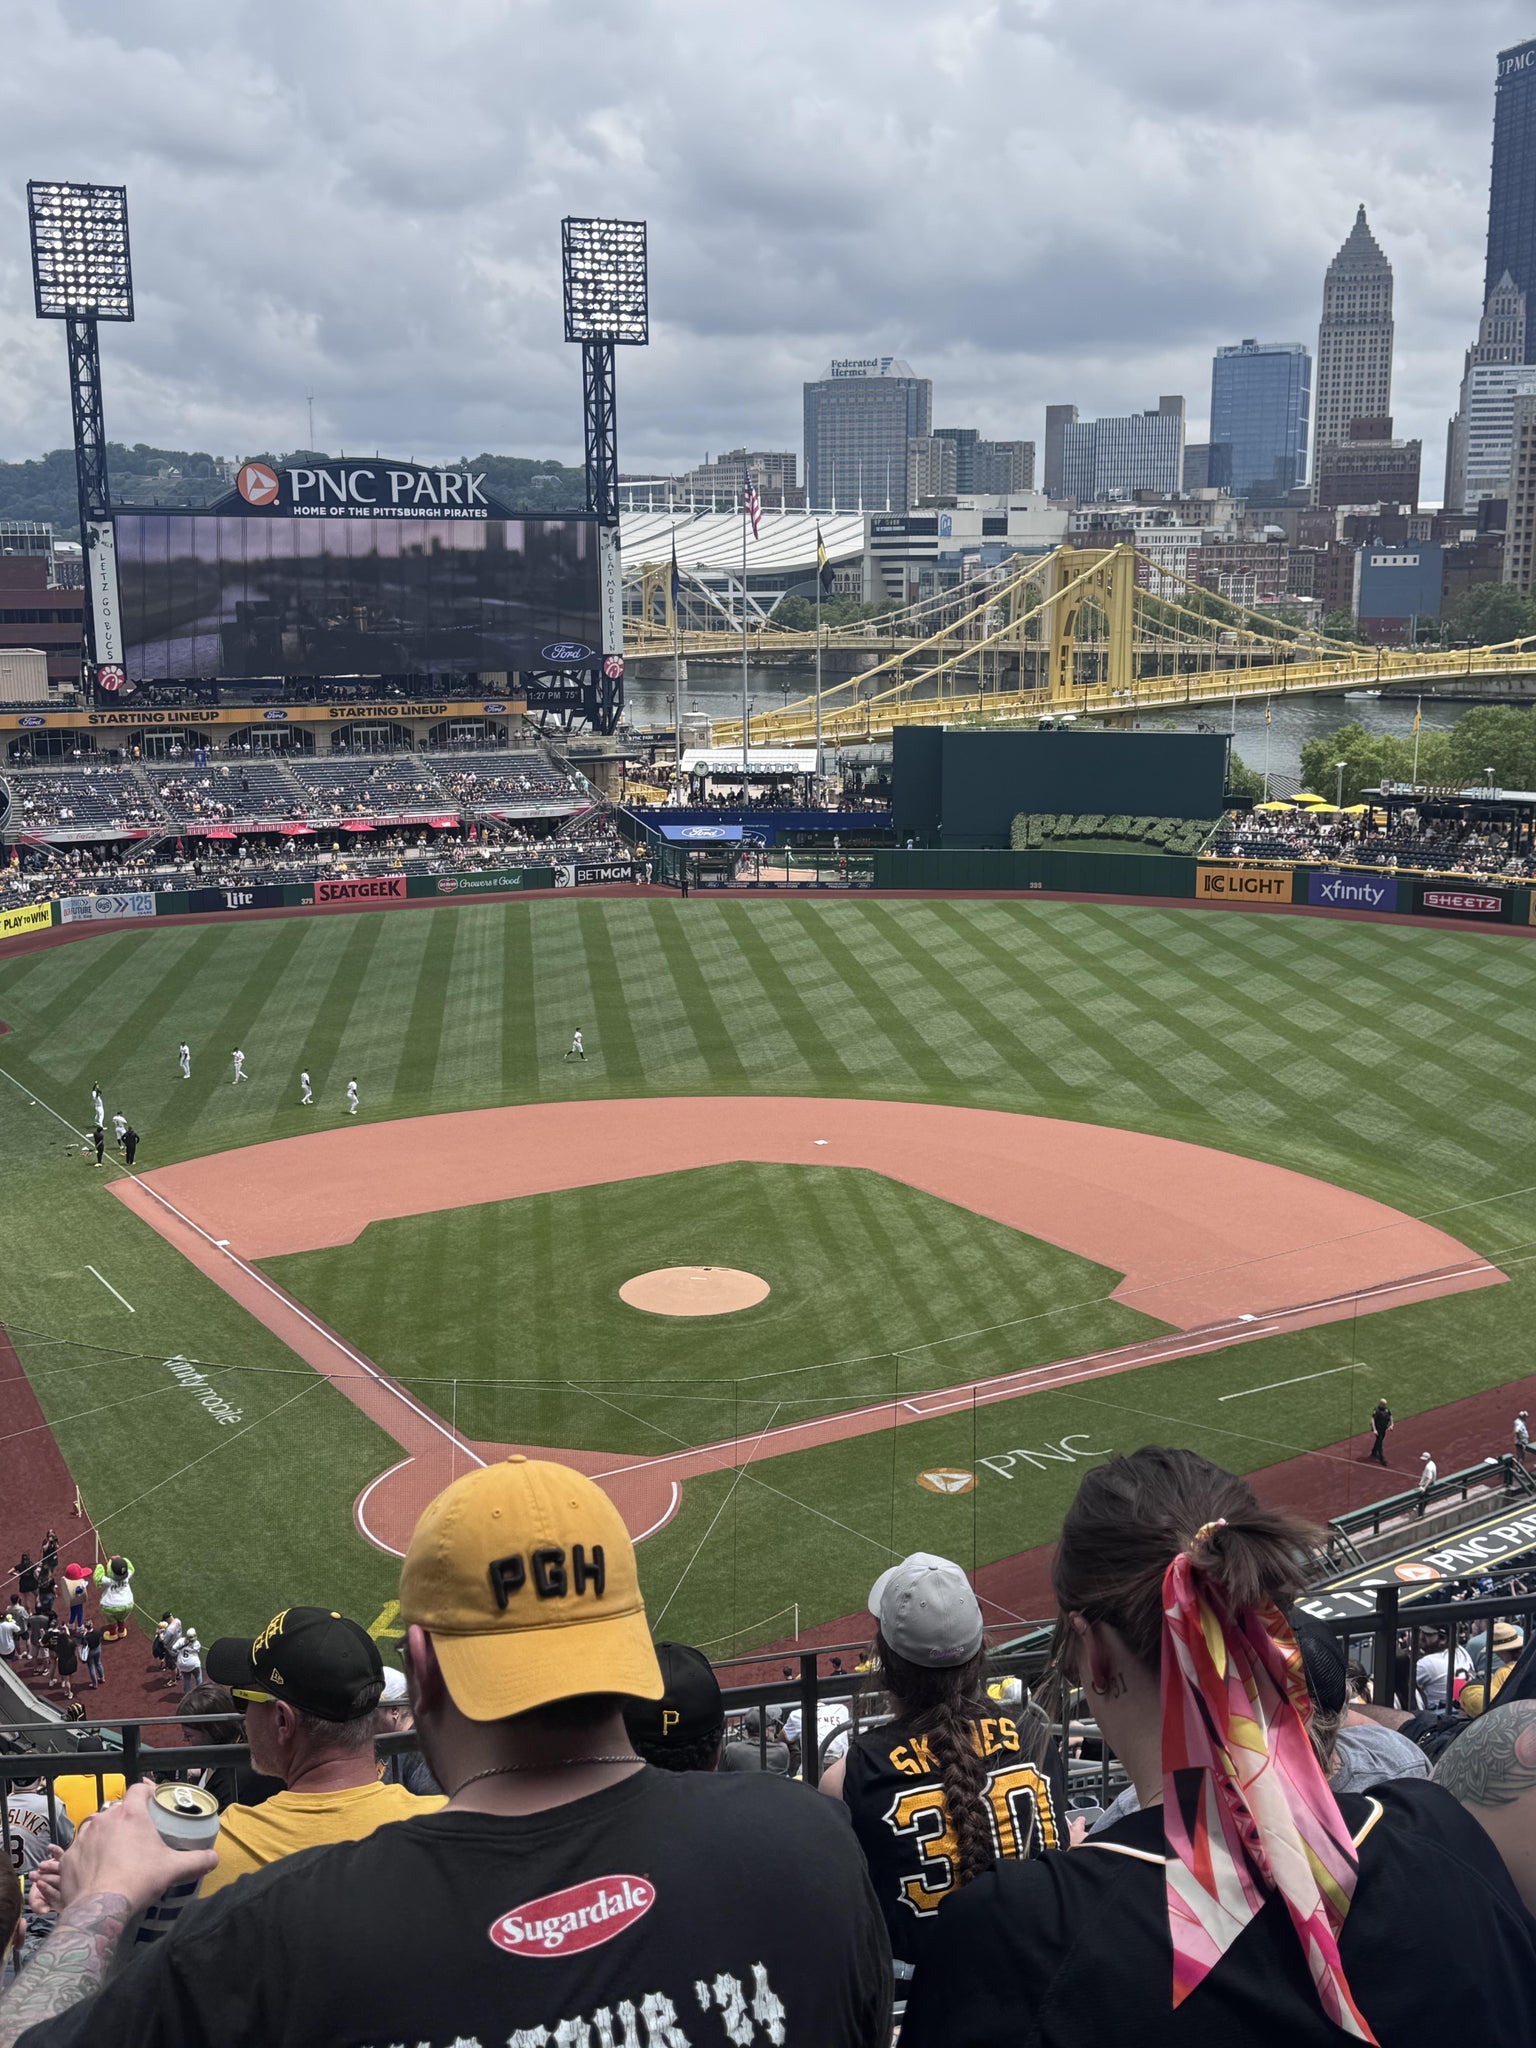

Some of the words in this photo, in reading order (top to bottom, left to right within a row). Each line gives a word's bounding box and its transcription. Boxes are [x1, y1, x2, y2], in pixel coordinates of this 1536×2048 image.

[1497, 50, 1535, 77] UPMC
[831, 358, 878, 368] Federated
[831, 368, 867, 377] Hermes
[286, 469, 376, 502] PNC
[386, 471, 489, 504] PARK
[293, 506, 327, 515] HOME
[329, 507, 346, 515] OF
[348, 507, 370, 516] THE
[373, 507, 441, 517] PITTSBURGH
[444, 508, 488, 518] PIRATES
[102, 598, 111, 616] GO
[551, 645, 582, 659] Ford
[548, 691, 561, 700] PM
[265, 710, 287, 719] Ford
[329, 706, 399, 718] STARTING
[401, 705, 447, 716] LINEUP
[485, 704, 506, 713] Ford
[21, 717, 43, 726] Ford
[88, 713, 165, 724] STARTING
[167, 711, 220, 722] LINEUP
[689, 828, 719, 837] Ford
[577, 866, 632, 881] BETMGM
[319, 880, 402, 901] SEATGEEK
[1229, 877, 1284, 894] LIGHT
[1320, 879, 1385, 906] xfinity
[129, 895, 152, 912] 125
[226, 892, 253, 909] Lite
[1428, 895, 1496, 909] SHEETZ
[4, 916, 24, 930] PLAY
[30, 910, 50, 923] WIN!
[190, 1388, 244, 1425] mobile
[975, 1434, 1113, 1480] PNC
[1423, 1536, 1508, 1571] PNC
[489, 1543, 606, 1611] PGH
[662, 1709, 680, 1736] P
[8, 1808, 48, 1836] SLYKE
[881, 1762, 1060, 1918] 30
[502, 1880, 649, 1949] Sugardale
